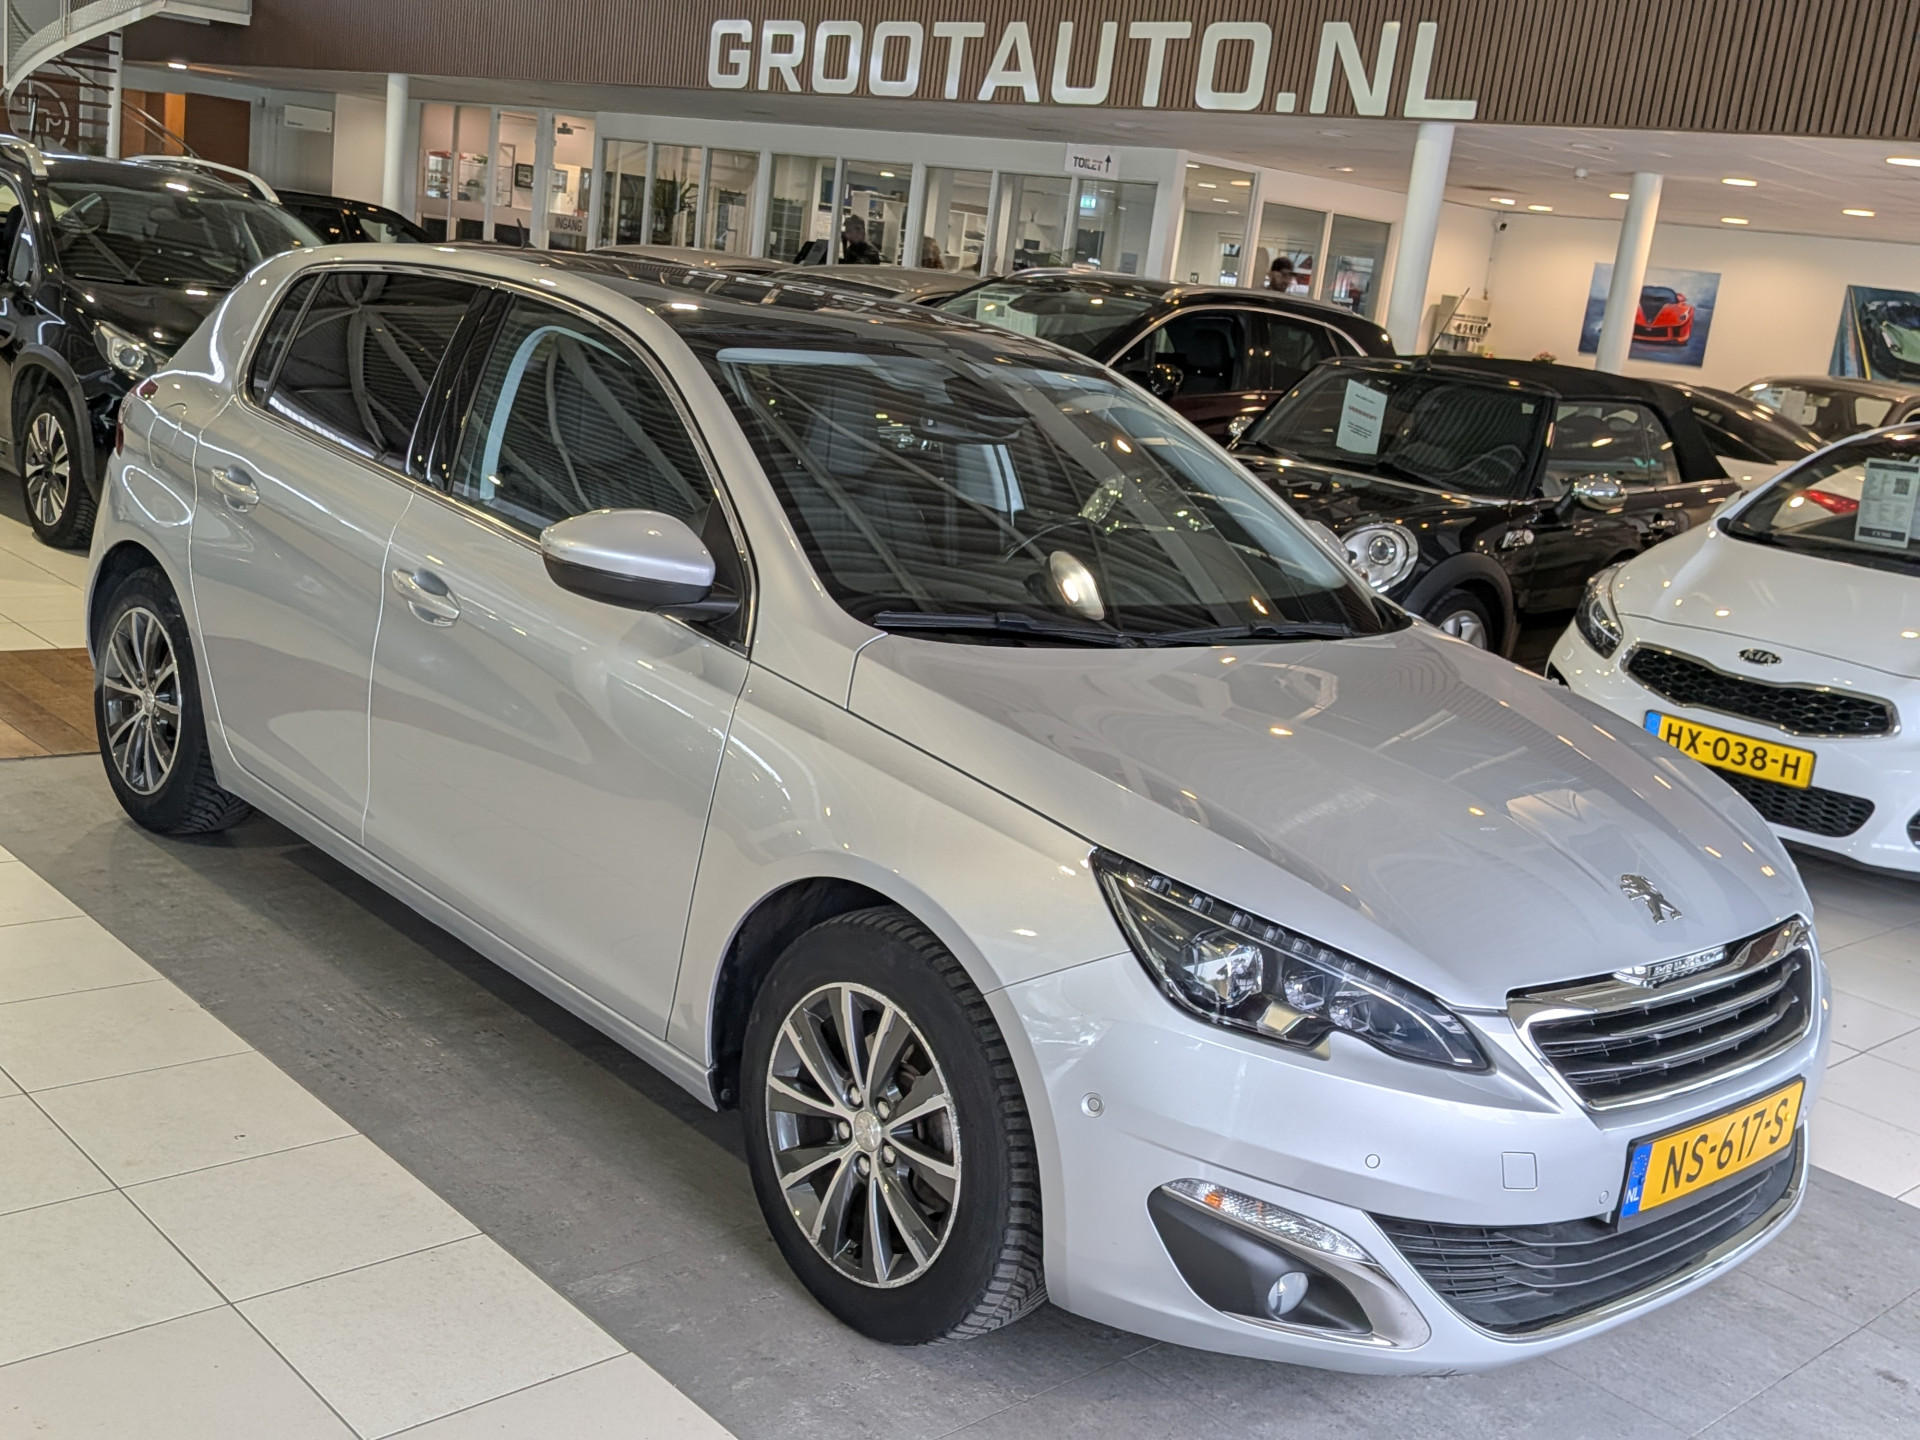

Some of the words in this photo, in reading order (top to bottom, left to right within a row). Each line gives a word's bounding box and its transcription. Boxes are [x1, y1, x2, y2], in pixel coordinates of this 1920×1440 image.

[707, 19, 1478, 119] GROOTAUTO.NL
[1073, 156, 1103, 171] TOILET
[555, 217, 583, 232] INGANG
[1744, 650, 1776, 664] KIA
[1665, 722, 1802, 781] HX-038-H
[1661, 1097, 1790, 1195] NS-617-S
[1625, 1186, 1640, 1205] NL
